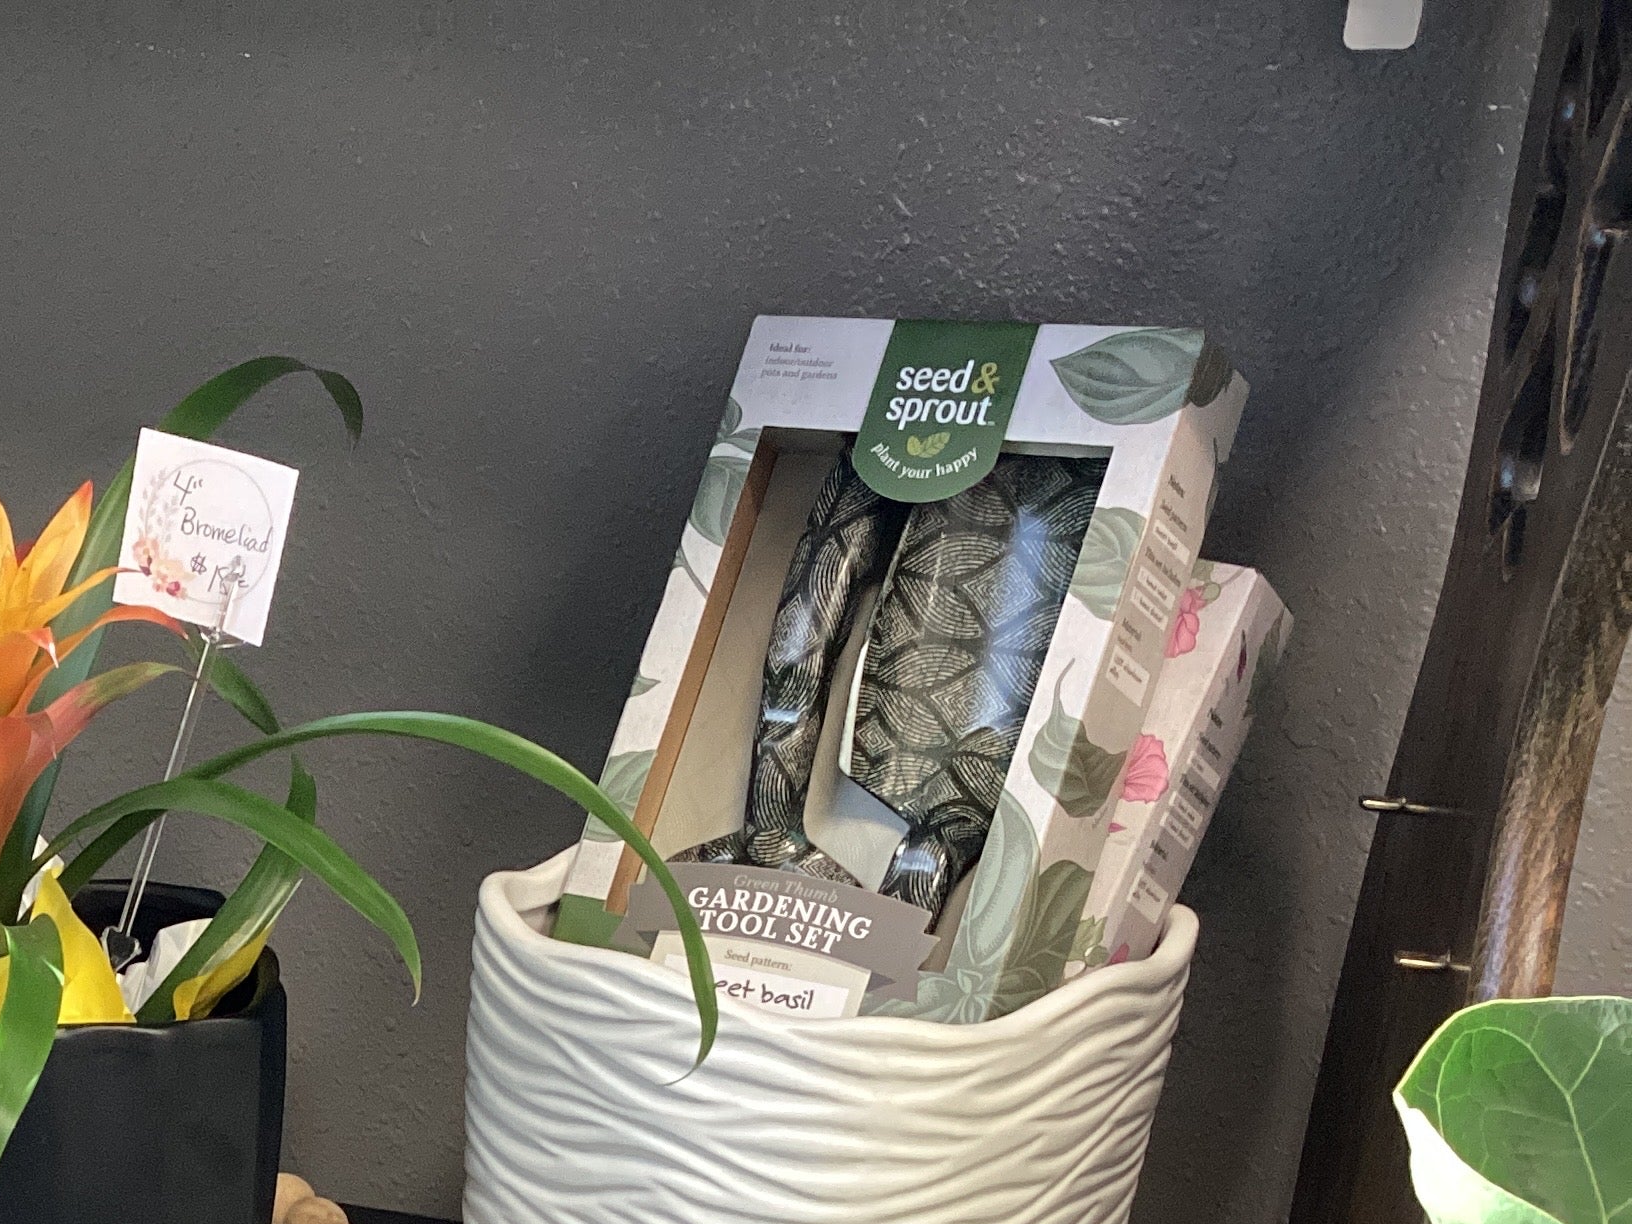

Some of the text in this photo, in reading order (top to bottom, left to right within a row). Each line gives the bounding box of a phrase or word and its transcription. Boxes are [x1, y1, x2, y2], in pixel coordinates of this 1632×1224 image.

[886, 396, 992, 430] sprout
[870, 442, 977, 479] plant your happy
[181, 506, 274, 553] Bromeliad
[733, 875, 838, 904] Green Thumb
[688, 887, 872, 940] GARDENING
[699, 909, 842, 954] TOOL SET
[725, 949, 792, 972] Seed pattern:
[714, 979, 815, 1010] eet basil
